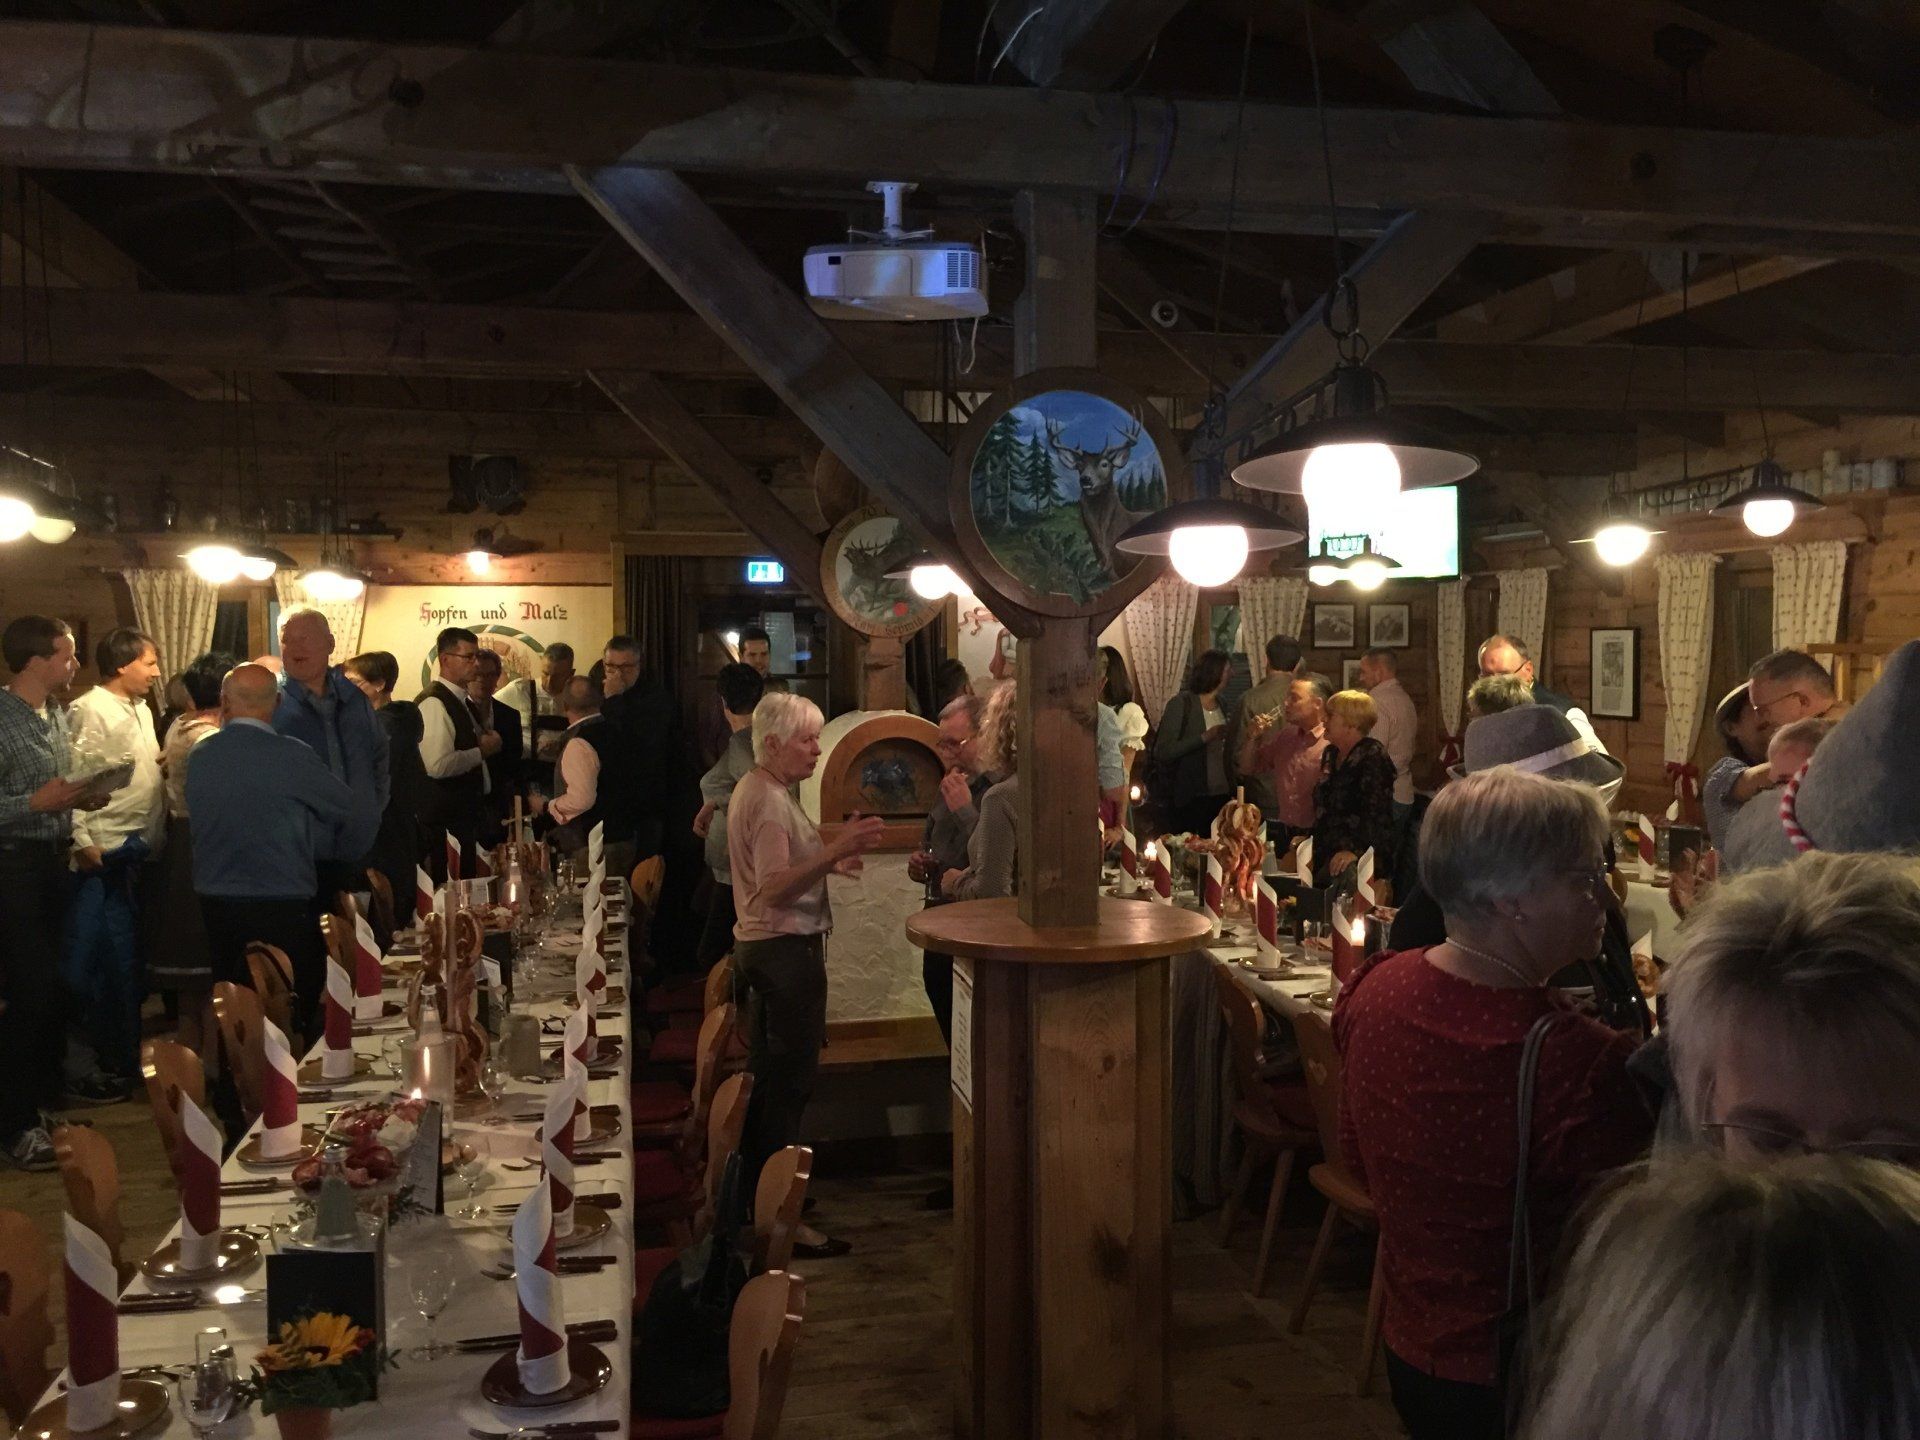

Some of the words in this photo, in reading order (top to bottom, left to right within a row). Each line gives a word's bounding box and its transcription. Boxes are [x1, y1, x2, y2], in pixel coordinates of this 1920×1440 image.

[419, 601, 468, 626] Hopfen
[480, 601, 507, 620] und
[519, 601, 568, 621] Malz
